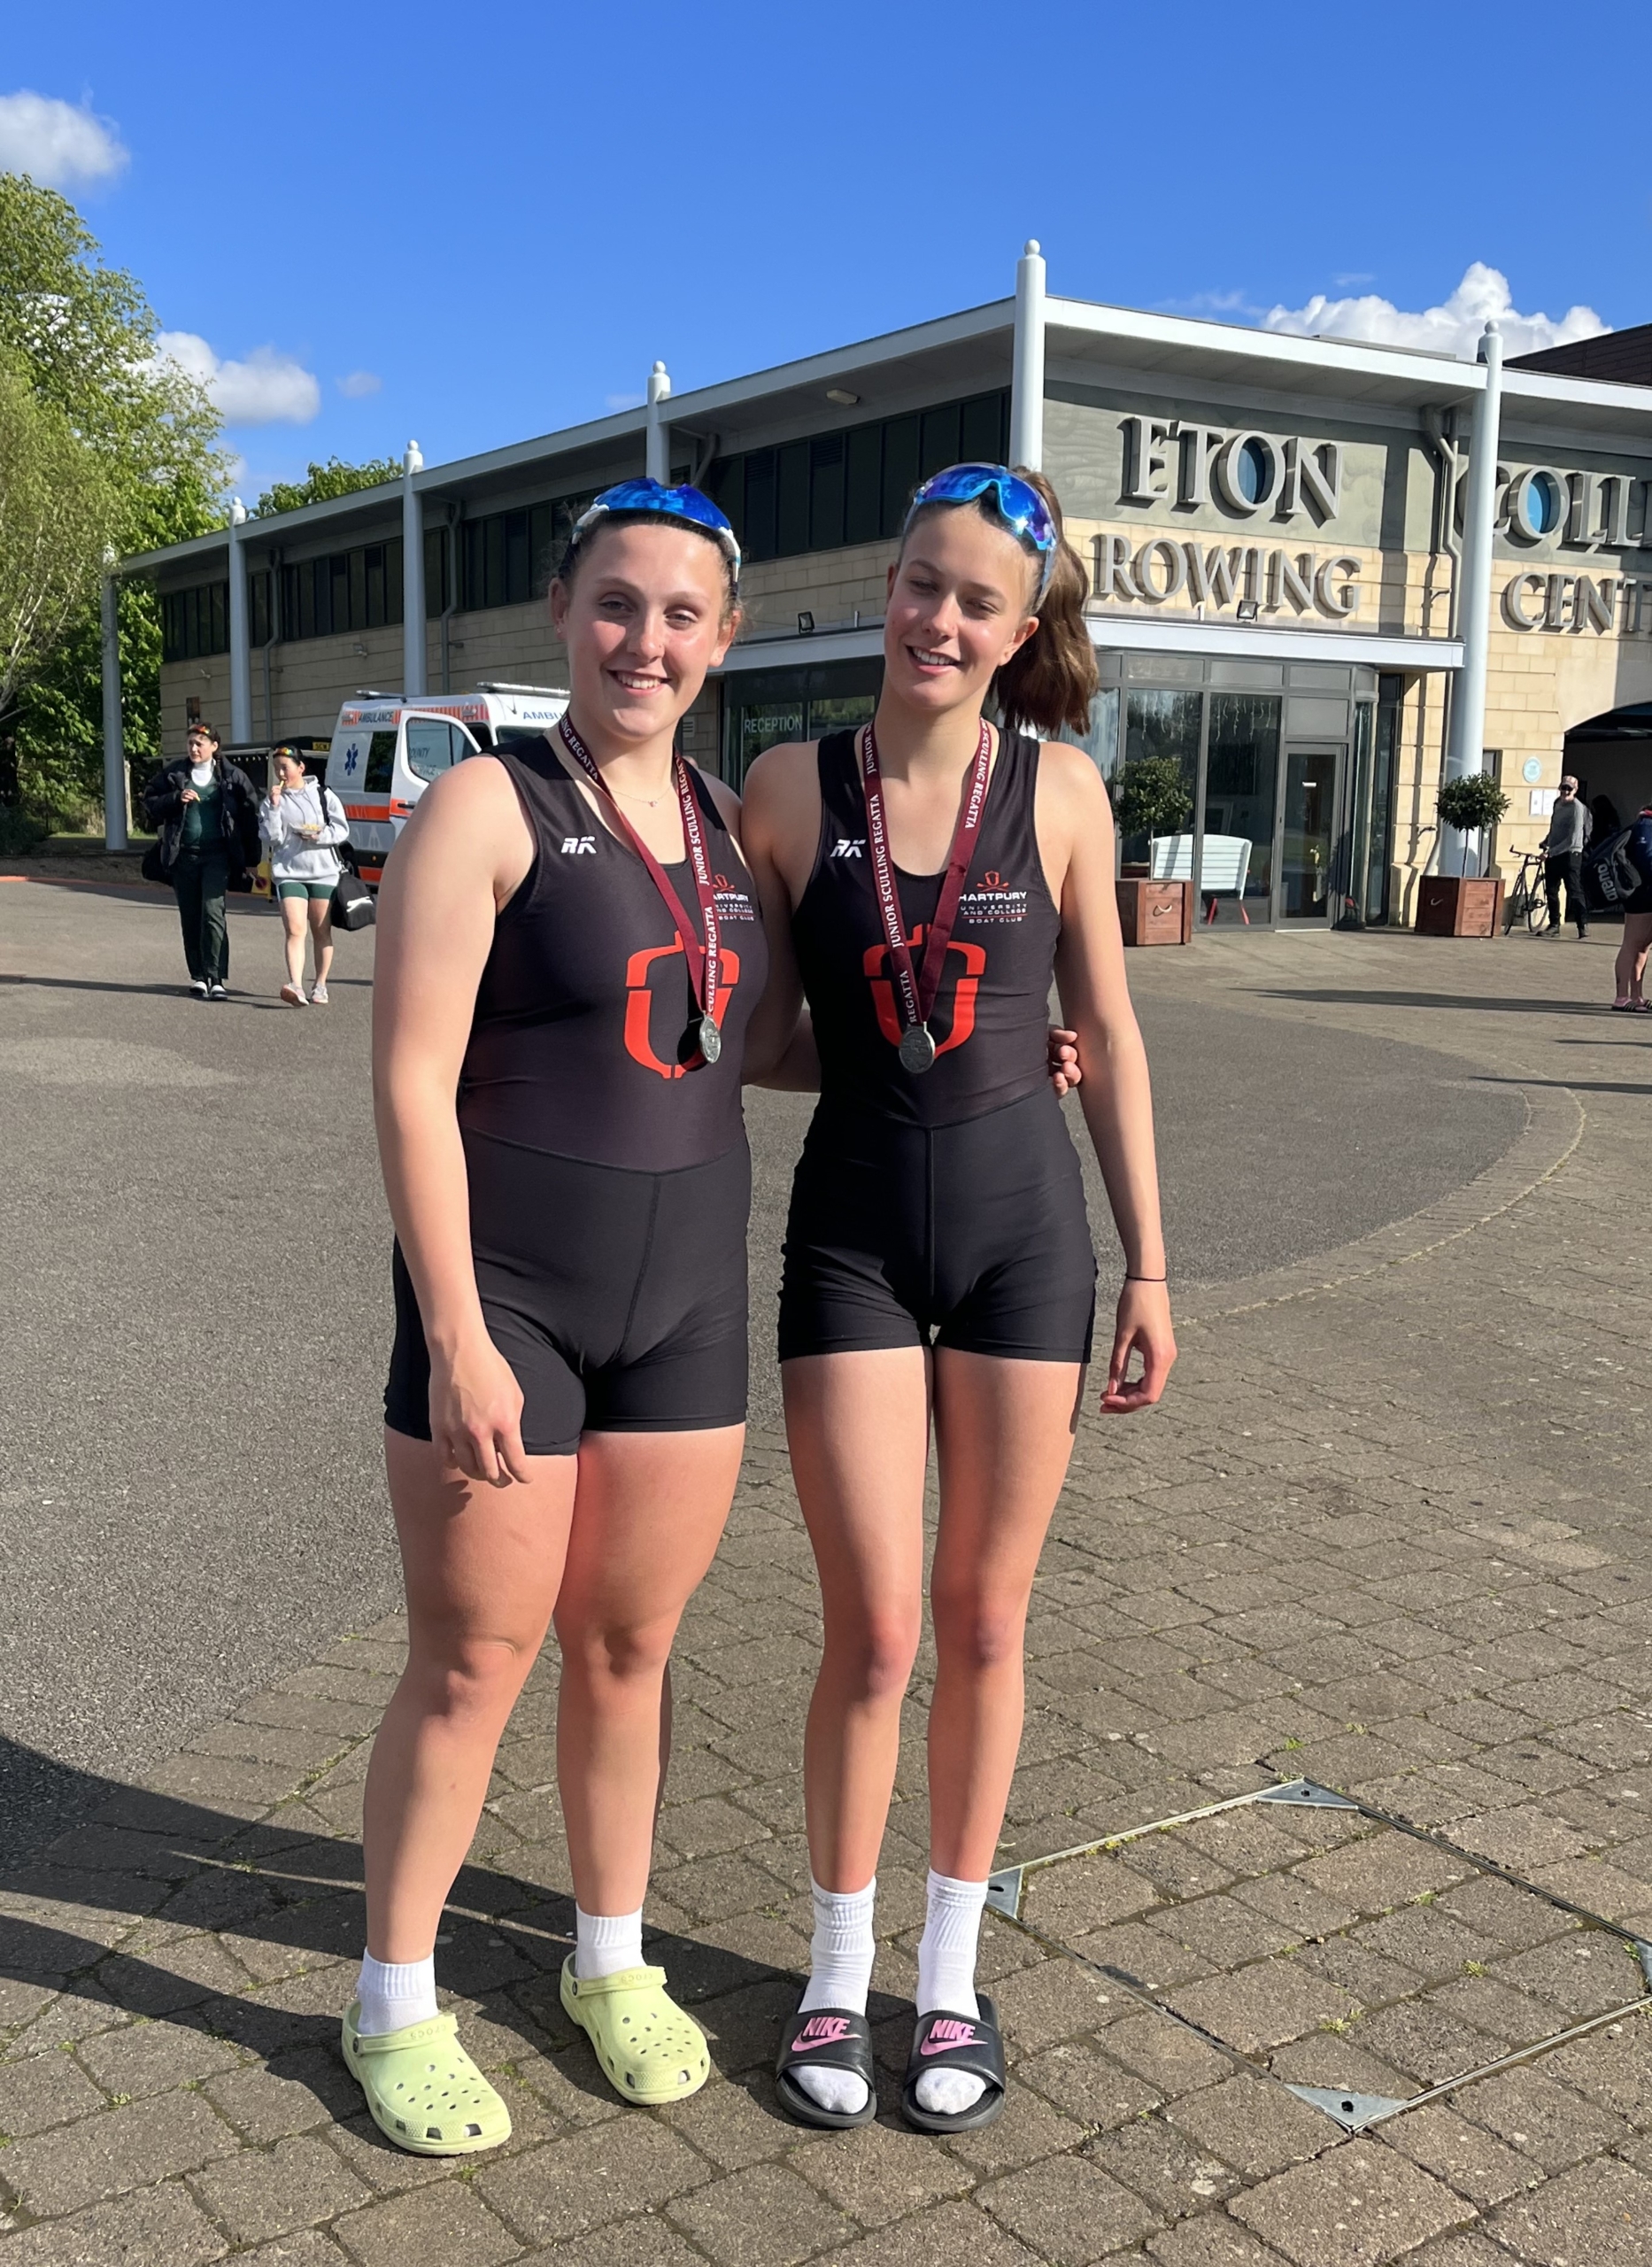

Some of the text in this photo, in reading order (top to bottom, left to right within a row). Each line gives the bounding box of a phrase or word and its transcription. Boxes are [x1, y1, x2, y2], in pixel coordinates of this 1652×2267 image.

[1117, 416, 1345, 528] ETON
[1089, 533, 1363, 615] ROWING
[358, 711, 395, 724] AMBULANCE
[744, 716, 802, 734] RECEPTION
[568, 736, 599, 780] REGATTA
[864, 734, 877, 775] JUNIOR
[976, 730, 990, 781] SCULLING
[683, 794, 702, 845] SCULLING
[964, 781, 984, 829] REGATTA
[692, 846, 710, 886] JUNIOR
[869, 793, 905, 948] JUNIOR SCULLING REGATTA
[959, 891, 1027, 902] HARTPURY
[704, 906, 718, 1016] CULLING REGATTA
[899, 969, 917, 1024] REGATTA
[802, 2016, 852, 2037] NIKE
[930, 2019, 977, 2041] NIKE
